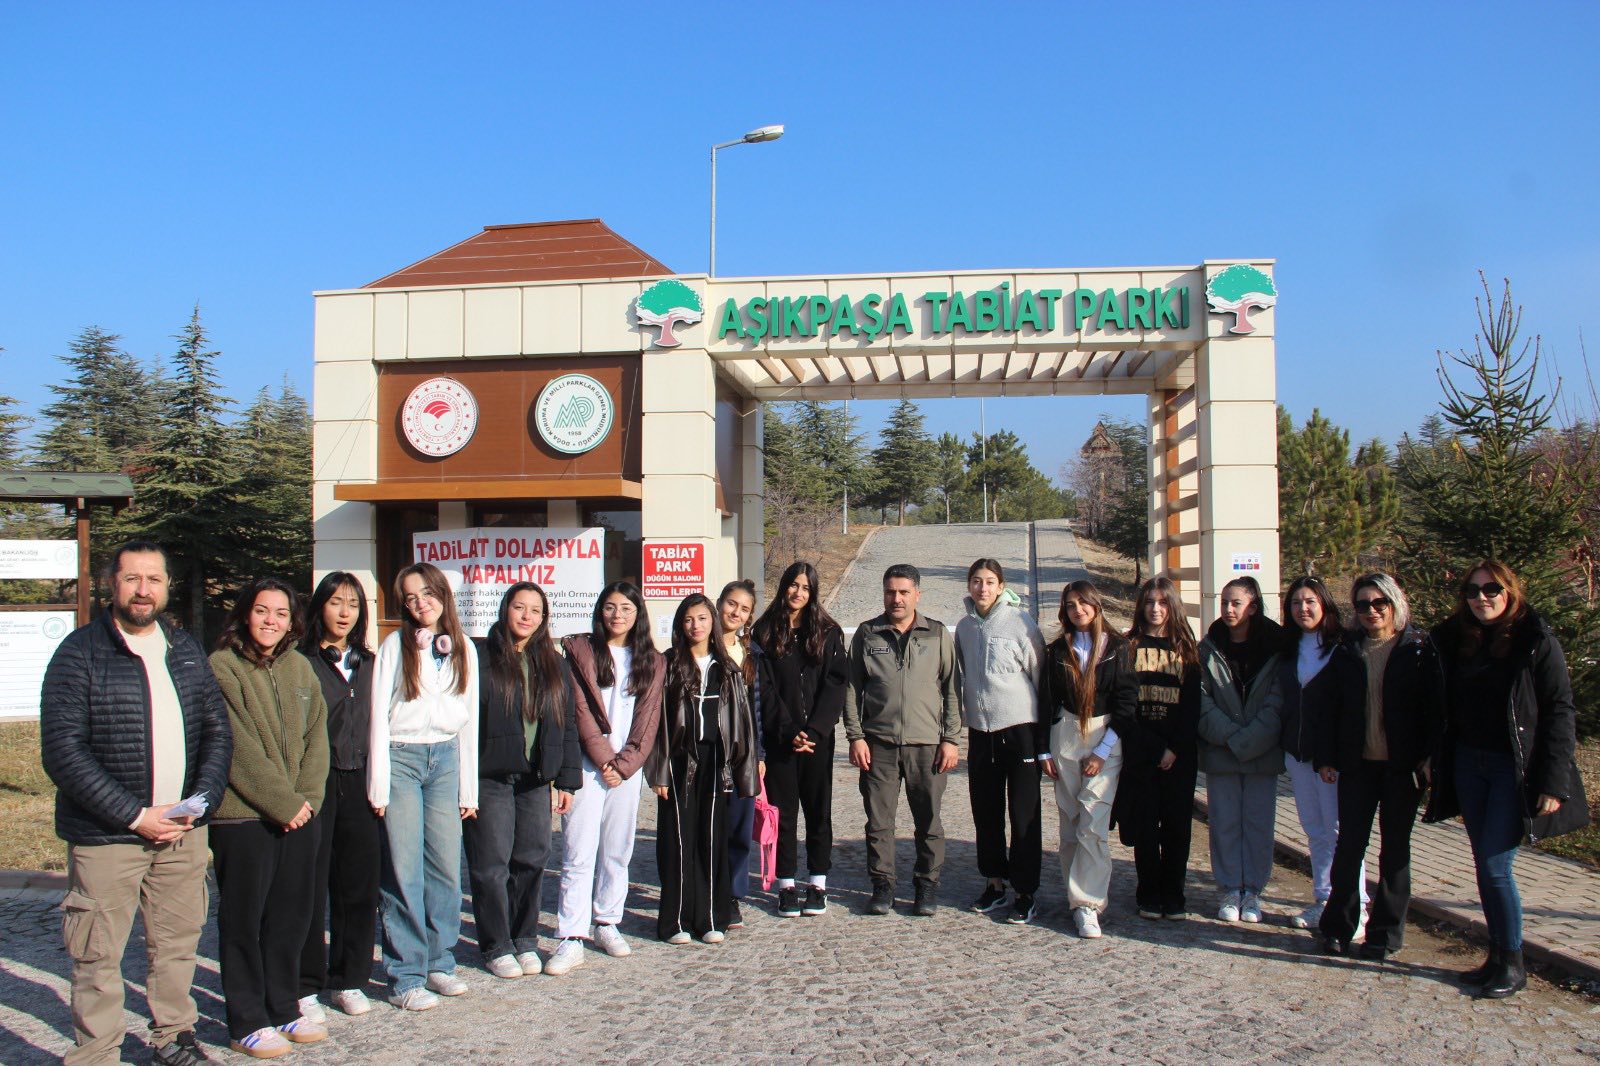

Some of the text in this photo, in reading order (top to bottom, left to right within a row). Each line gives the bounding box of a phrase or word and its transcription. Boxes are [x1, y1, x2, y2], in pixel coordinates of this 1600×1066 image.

[718, 281, 1190, 346] AŞIKPAŞA TABİAT PARKI
[549, 382, 566, 397] MİLLİ
[566, 380, 596, 393] PARKLAR
[543, 396, 551, 406] VE
[595, 391, 607, 412] GENEL
[541, 407, 554, 436] KORUMA
[553, 434, 571, 447] DOĞA
[495, 538, 601, 559] DOLASIYLA
[650, 544, 698, 559] TABİAT
[656, 561, 692, 572] PARK
[462, 564, 556, 585] KAPALIYIZ
[646, 574, 672, 582] DÜĞÜN
[568, 590, 599, 598] Orman
[645, 588, 669, 596] 900m
[475, 600, 498, 608] sayılı
[552, 600, 587, 608] Kanunu
